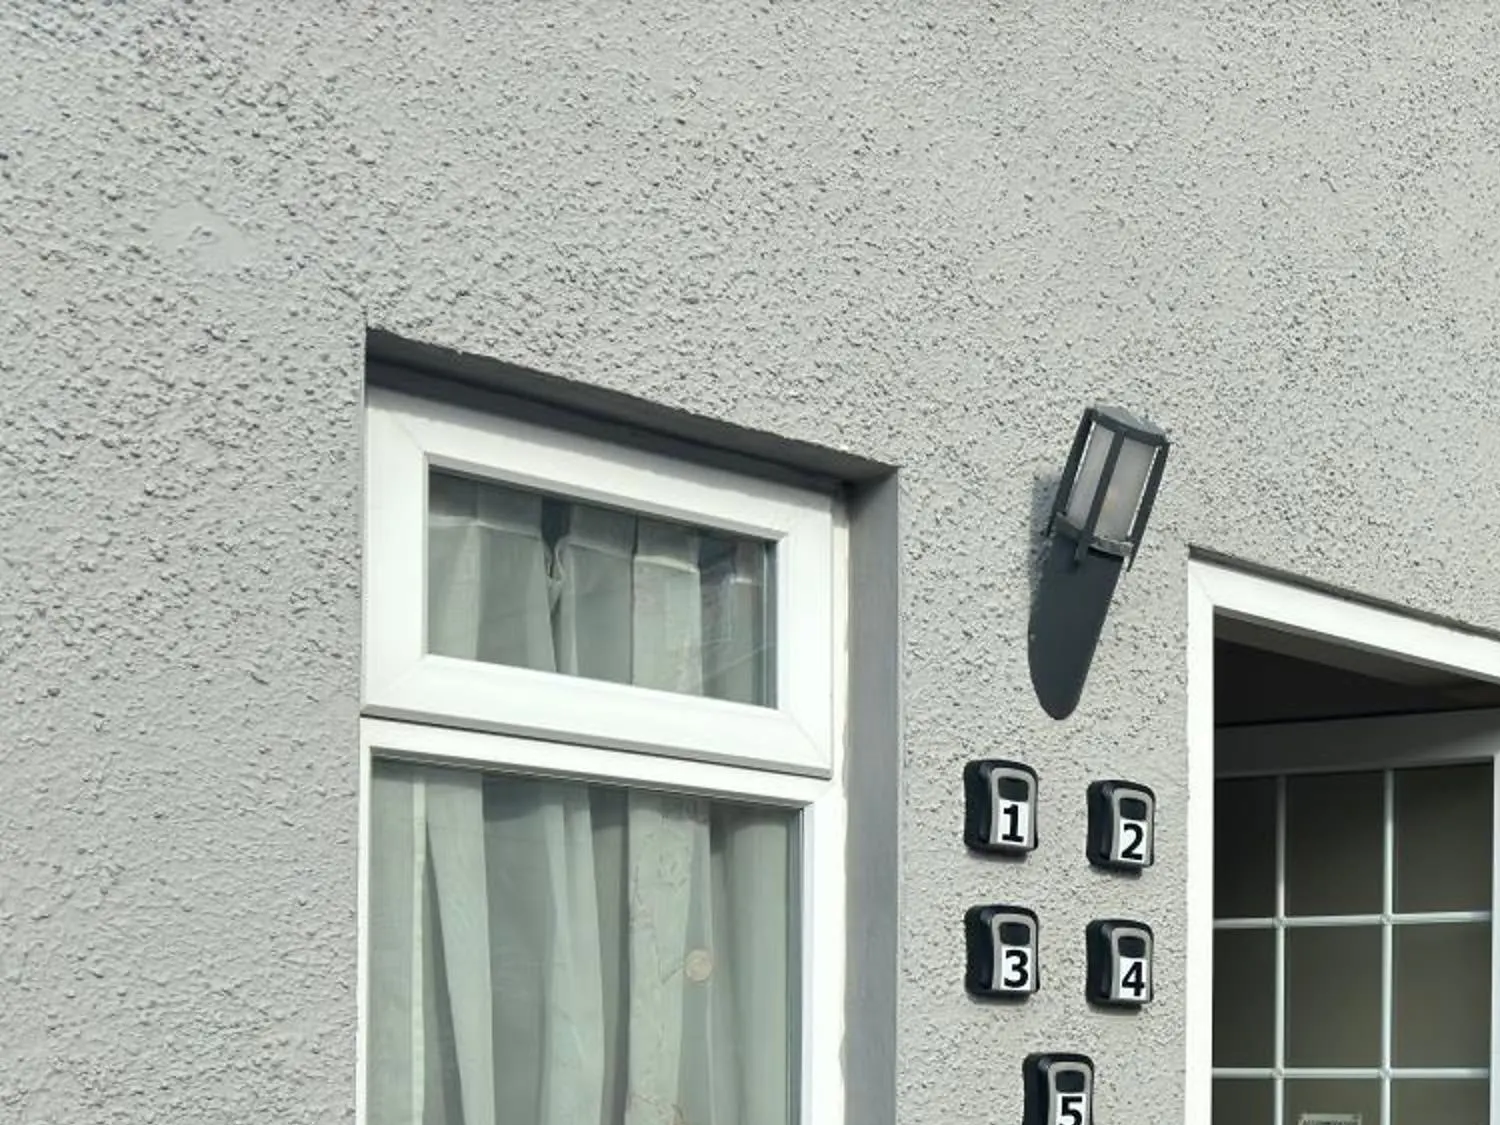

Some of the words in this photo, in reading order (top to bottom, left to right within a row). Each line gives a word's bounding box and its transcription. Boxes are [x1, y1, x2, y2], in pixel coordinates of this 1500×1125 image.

[1001, 804, 1024, 843] 1
[1121, 823, 1143, 860] 2
[1003, 950, 1029, 987] 3
[1121, 961, 1145, 996] 4
